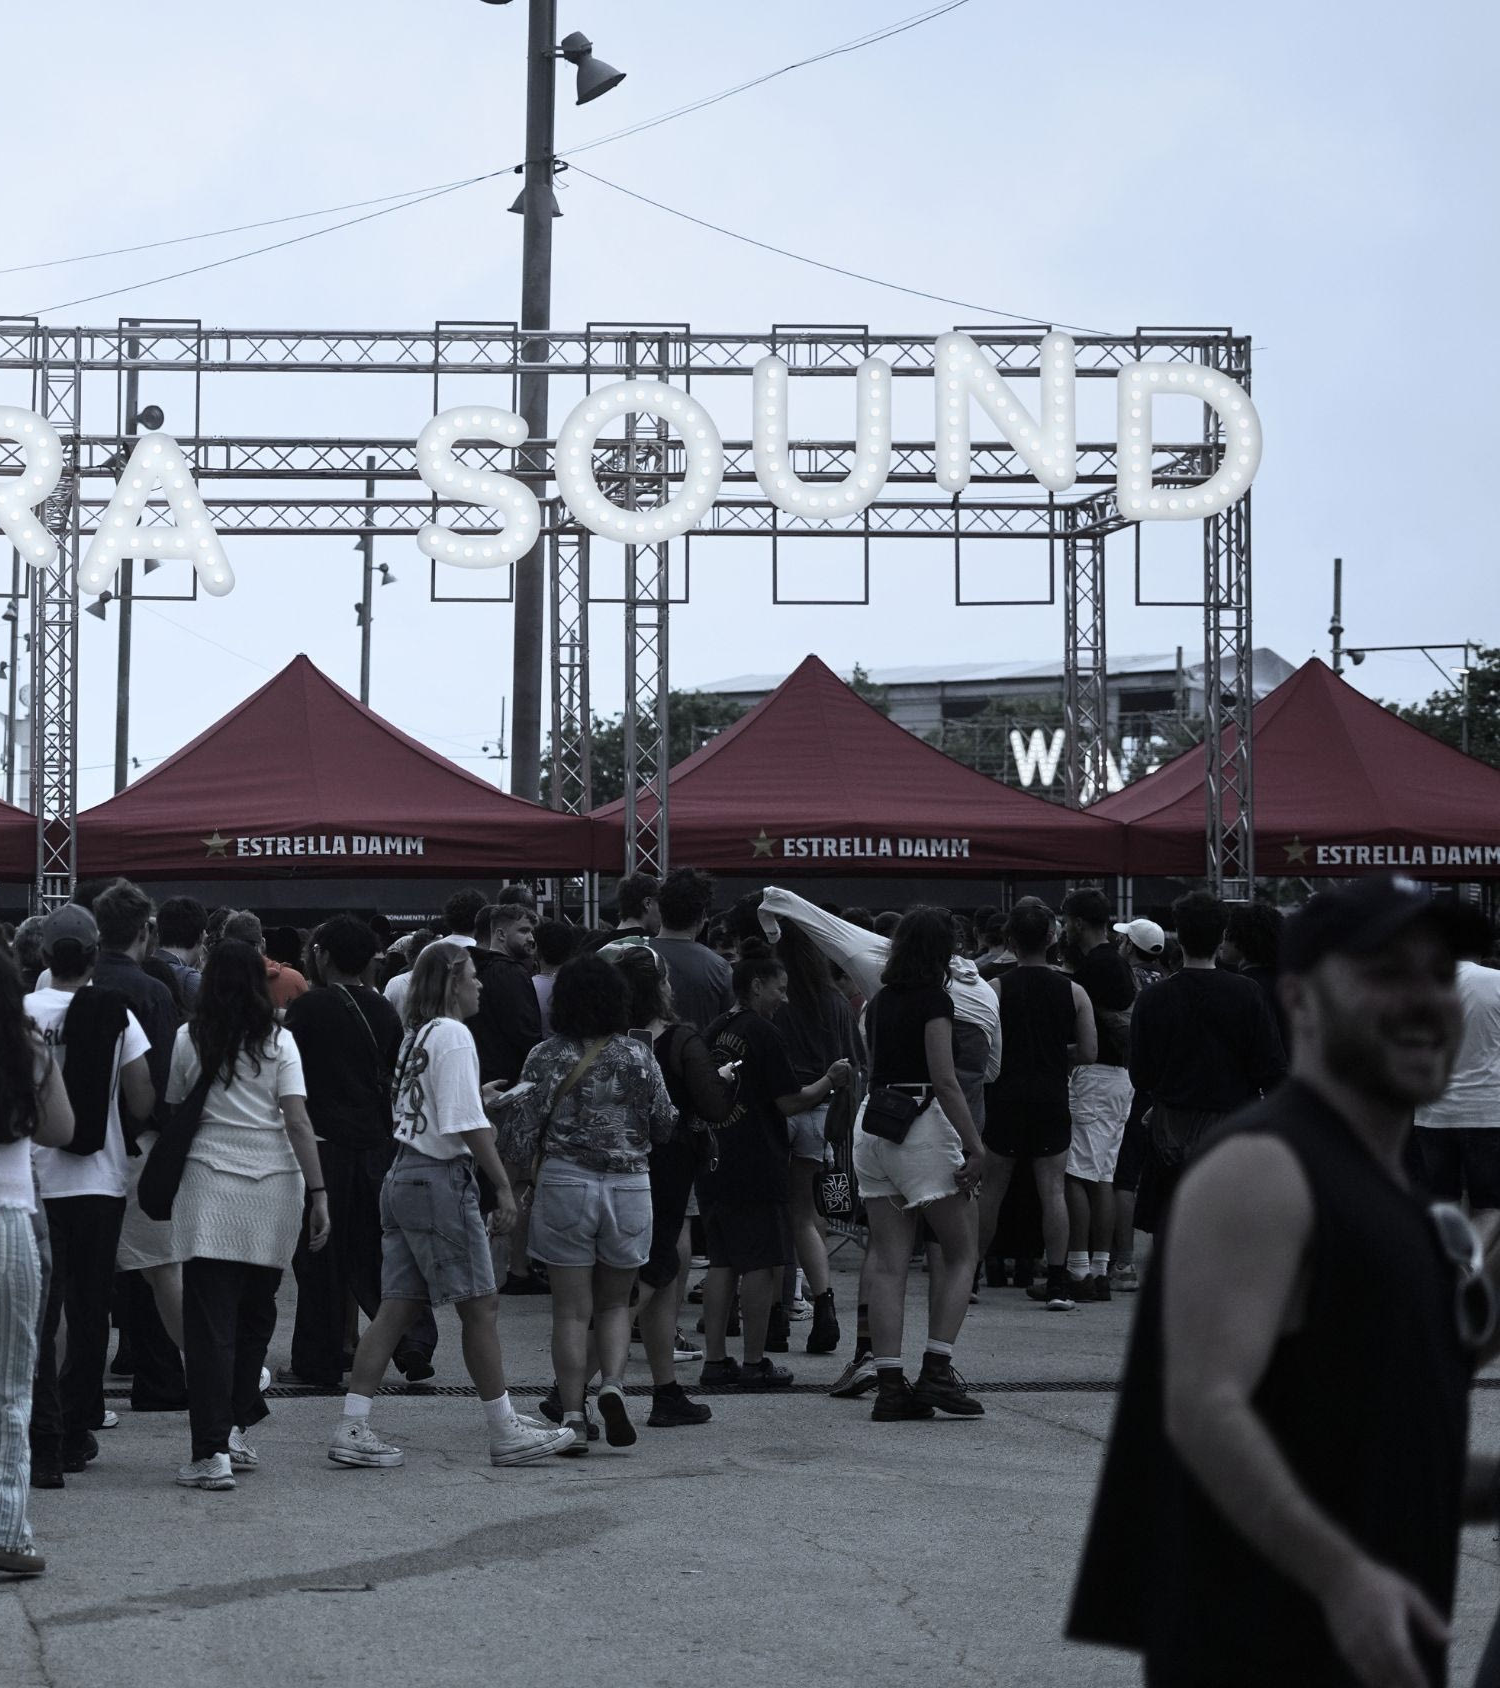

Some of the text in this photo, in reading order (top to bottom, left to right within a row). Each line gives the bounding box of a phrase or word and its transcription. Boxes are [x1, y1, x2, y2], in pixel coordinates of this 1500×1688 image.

[416, 331, 1263, 569] SOUND
[237, 836, 424, 856] ESTRELLA DAMM
[783, 837, 970, 857] ESTRELLA DAMM
[1316, 845, 1500, 865] ESTRELLA DAMM
